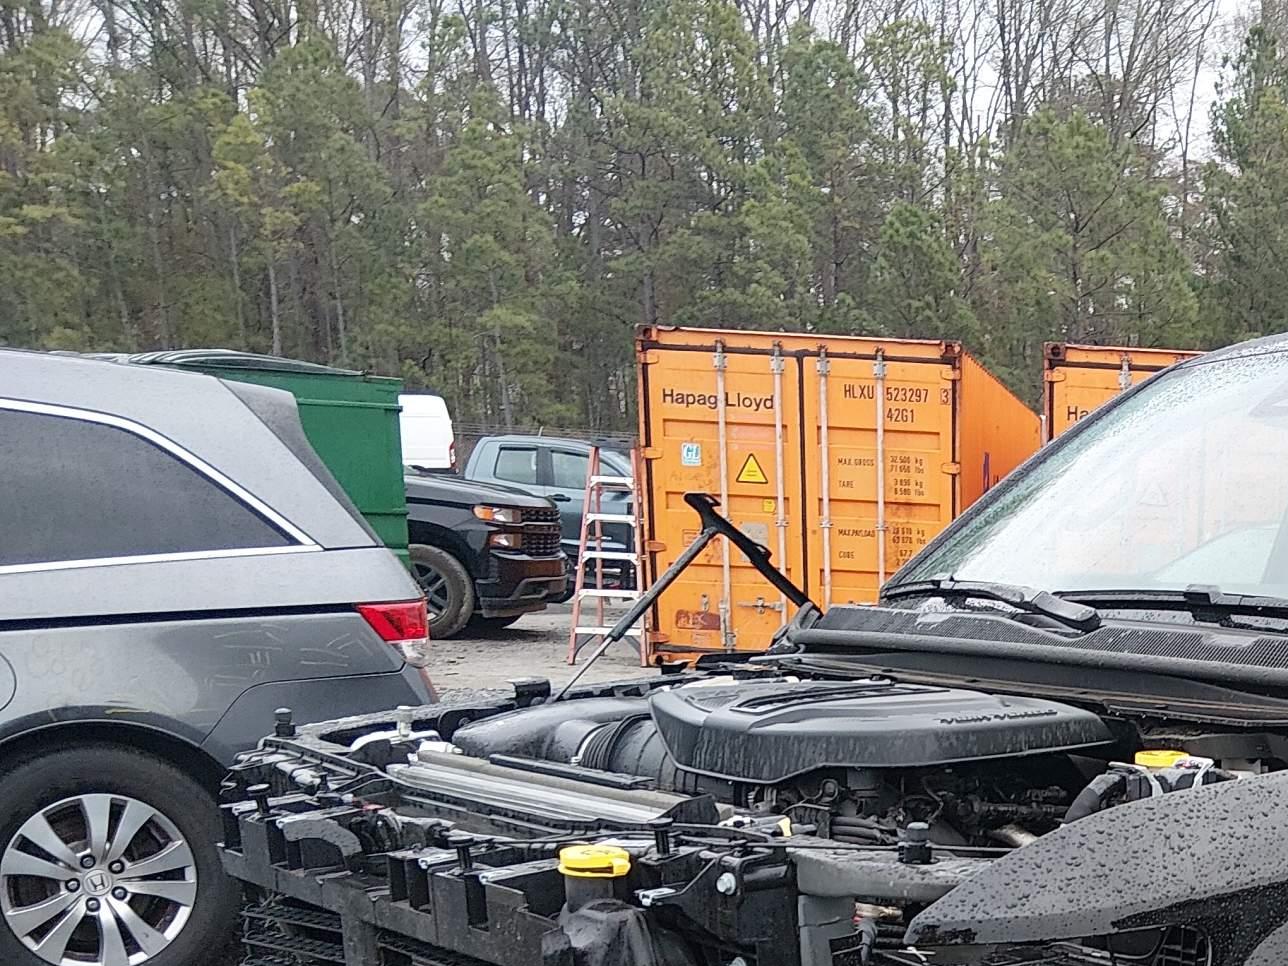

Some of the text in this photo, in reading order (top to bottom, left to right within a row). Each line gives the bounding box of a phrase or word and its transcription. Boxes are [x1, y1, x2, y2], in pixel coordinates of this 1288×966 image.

[662, 388, 774, 412] Hapag Lloyd
[844, 384, 949, 404] HLXU 523297 3
[886, 407, 915, 423] 42G1
